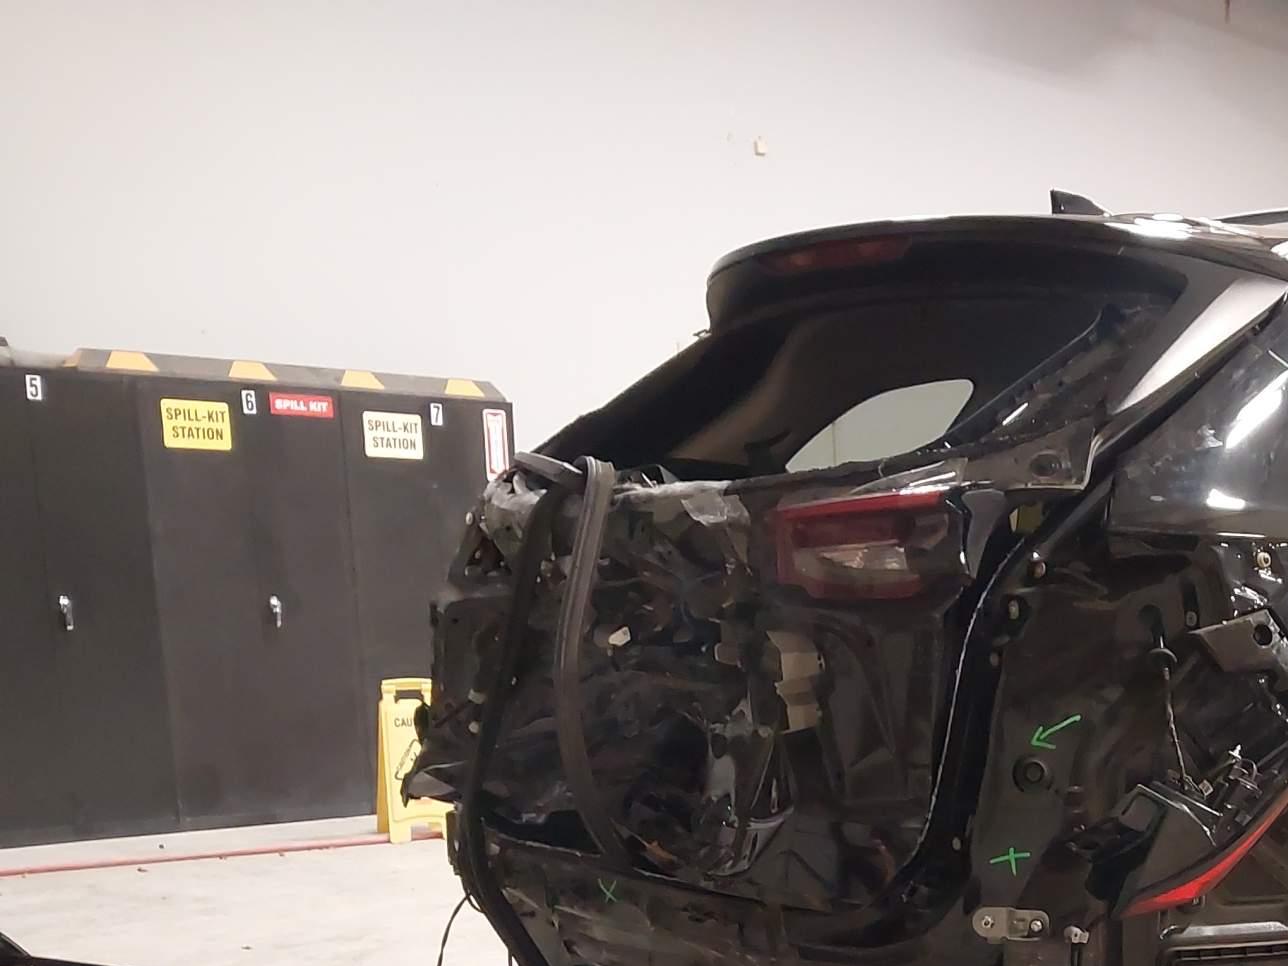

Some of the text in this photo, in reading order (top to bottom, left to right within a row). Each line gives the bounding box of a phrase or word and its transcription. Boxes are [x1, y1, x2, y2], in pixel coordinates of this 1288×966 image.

[30, 377, 39, 398] 5
[244, 392, 254, 411] 6
[274, 398, 329, 412] SPILL KIT
[166, 407, 227, 423] SPILL-KIT
[433, 404, 441, 424] 7
[172, 425, 224, 441] STATION
[367, 419, 419, 434] SPILL-KIT
[372, 436, 417, 450] STATION
